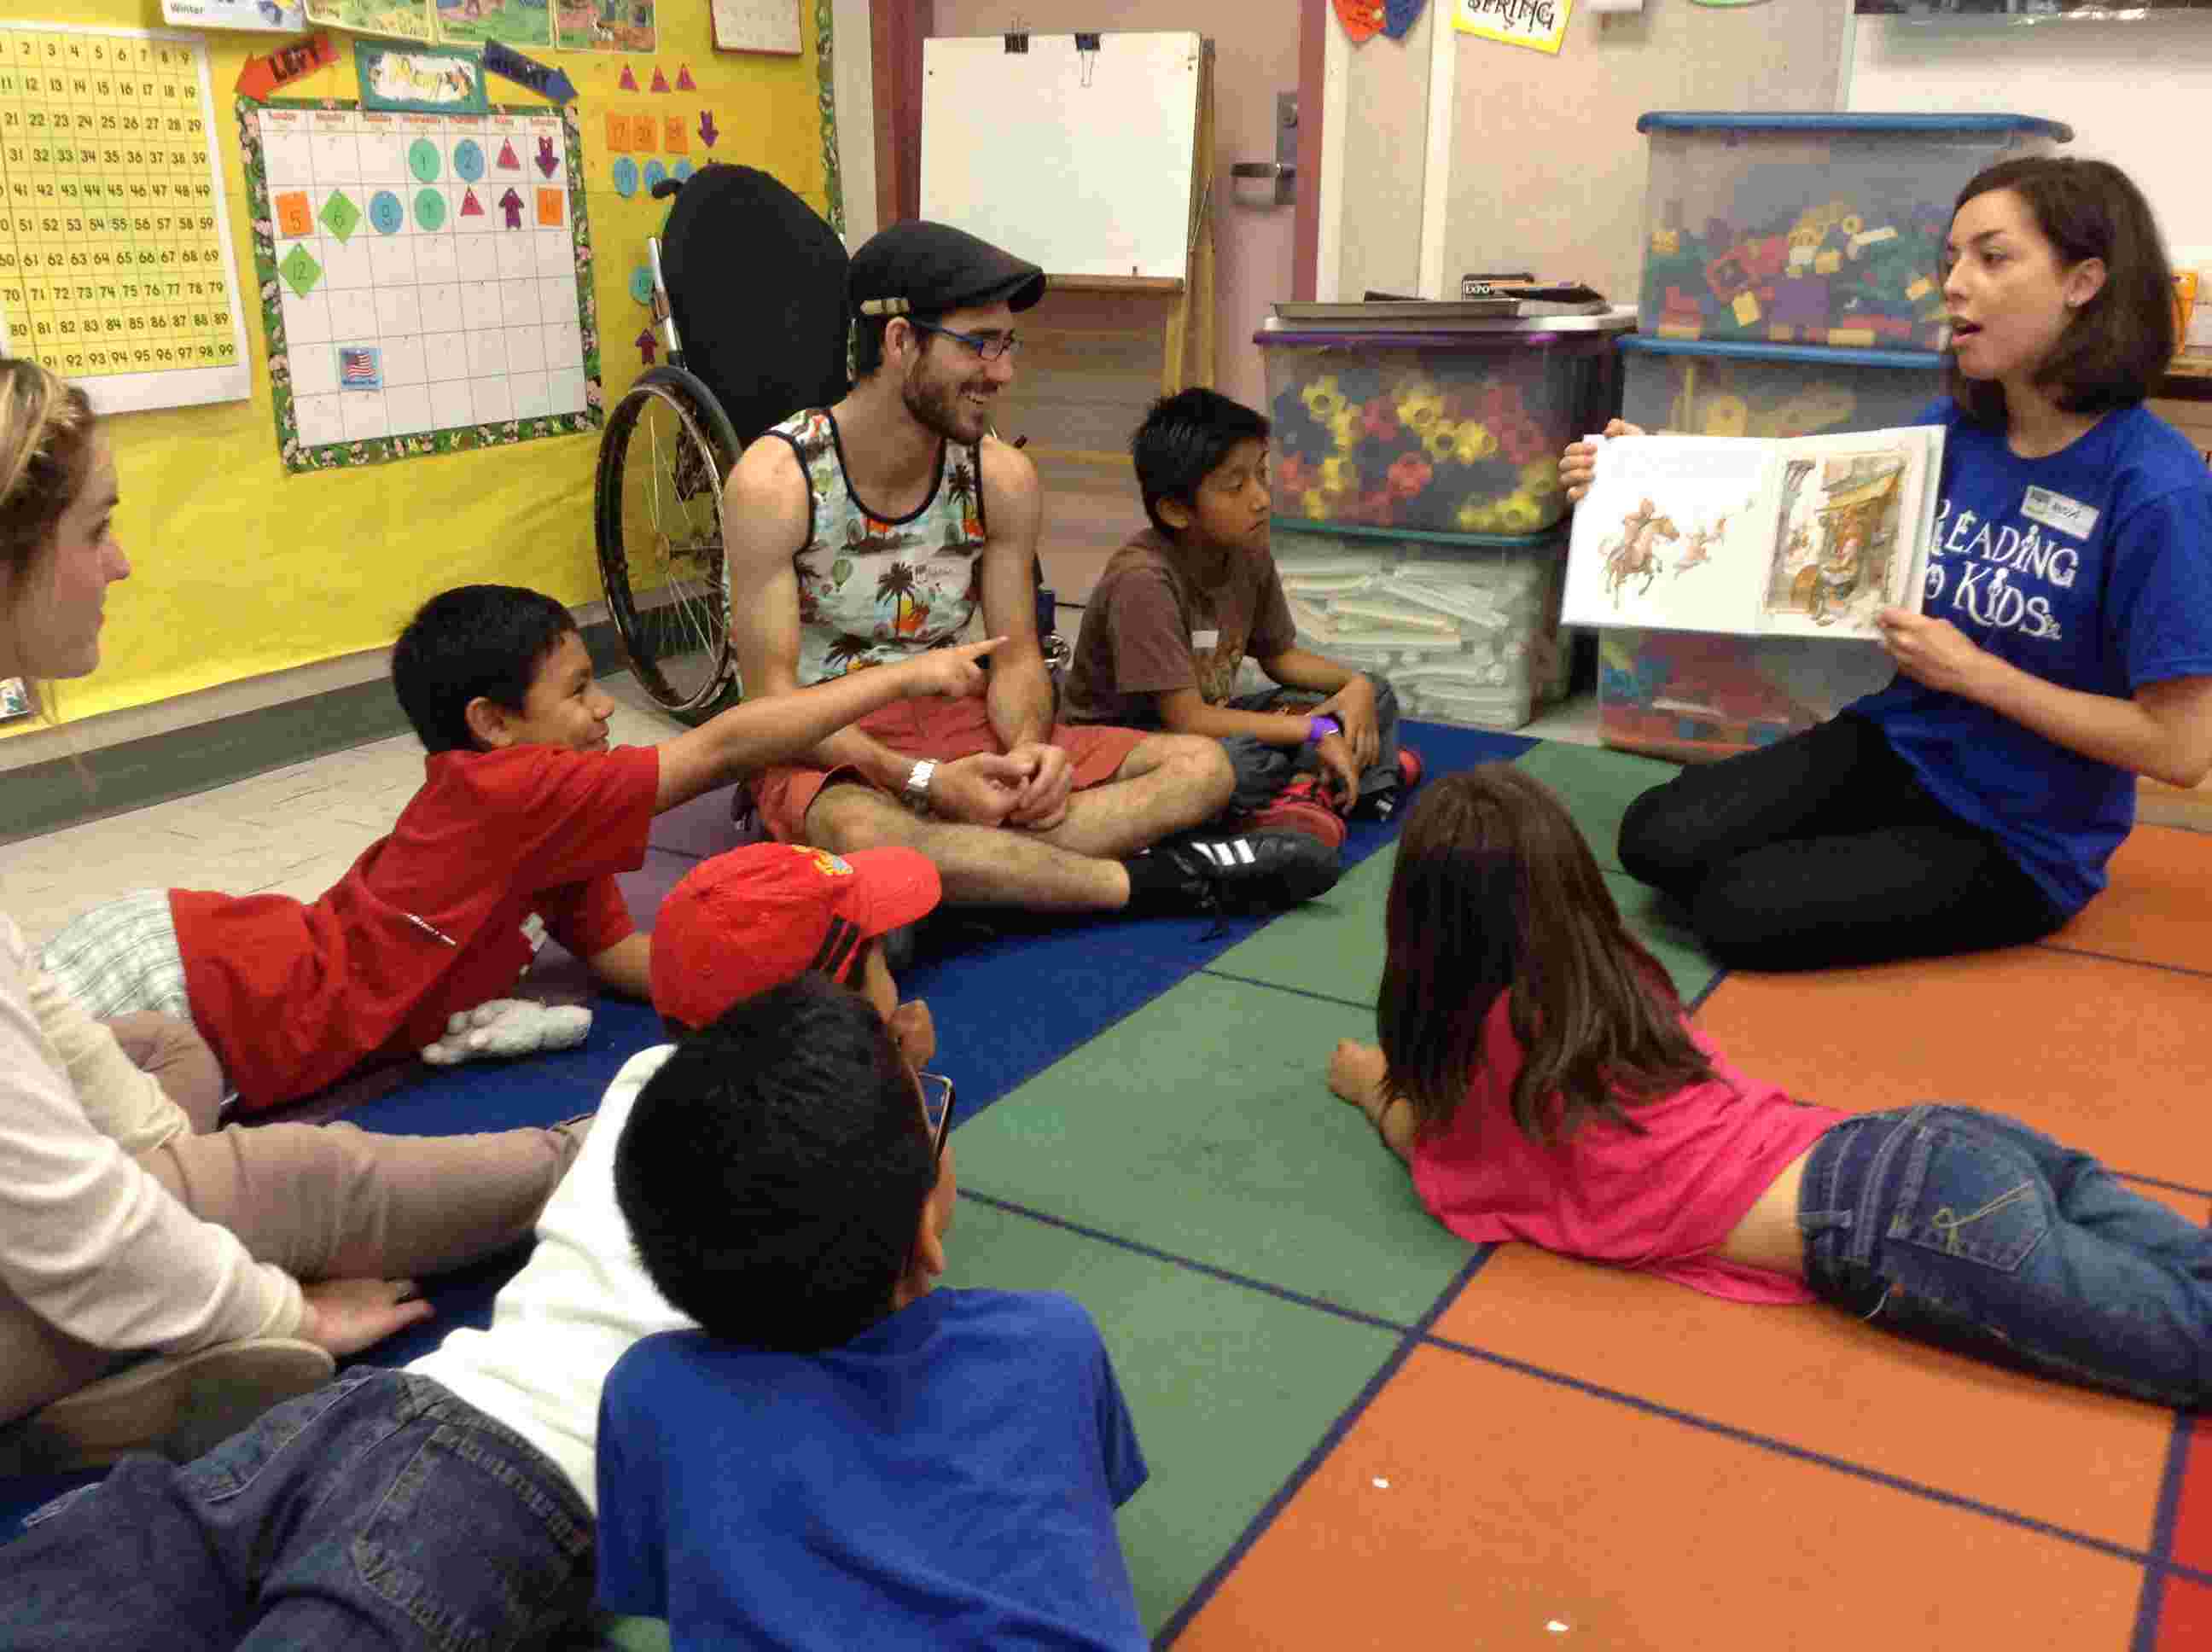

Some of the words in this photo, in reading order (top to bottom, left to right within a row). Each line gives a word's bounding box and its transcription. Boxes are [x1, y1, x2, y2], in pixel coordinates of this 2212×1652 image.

[171, 4, 203, 15] Winter
[22, 43, 30, 55] 2
[48, 44, 55, 56] 3
[71, 46, 79, 57] 4
[96, 46, 102, 59] 5
[118, 49, 126, 61] 6
[141, 49, 147, 61] 7
[180, 50, 189, 64] 9
[1, 78, 12, 89] 11
[26, 77, 38, 90] 12
[50, 79, 61, 91] 13
[74, 80, 86, 92] 14
[97, 82, 109, 96] 15
[120, 84, 132, 95] 16
[143, 84, 153, 96] 17
[164, 85, 174, 97] 18
[184, 86, 195, 98] 19
[4, 112, 19, 125] 21
[29, 113, 44, 126] 22
[55, 114, 68, 127] 23
[78, 115, 92, 128] 24
[101, 116, 115, 129] 25
[124, 116, 138, 130] 26
[146, 118, 159, 130] 27
[167, 118, 181, 131] 28
[188, 119, 201, 132] 29
[9, 148, 23, 161] 31
[34, 148, 48, 162] 32
[57, 149, 73, 162] 33
[80, 150, 96, 163] 34
[104, 150, 119, 163] 35
[127, 151, 143, 164] 36
[150, 151, 163, 164] 37
[193, 152, 206, 164] 39
[14, 184, 27, 196] 41
[37, 184, 53, 195] 42
[61, 184, 77, 197] 43
[84, 184, 100, 196] 44
[108, 184, 123, 196] 45
[130, 184, 146, 197] 46
[152, 184, 166, 196] 47
[175, 184, 189, 197] 48
[195, 184, 210, 196] 49
[0, 218, 9, 231] 0
[20, 218, 32, 231] 51
[43, 218, 58, 231] 52
[67, 218, 82, 231] 53
[89, 218, 104, 231] 54
[112, 218, 128, 230] 55
[157, 218, 171, 230] 57
[179, 218, 194, 230] 58
[200, 217, 213, 230] 59
[290, 210, 301, 231] 5
[334, 207, 346, 229] 6
[23, 254, 38, 266] 61
[48, 253, 63, 266] 62
[71, 253, 87, 265] 63
[94, 253, 109, 265] 64
[116, 252, 132, 265] 65
[139, 253, 155, 264] 66
[161, 251, 175, 263] 67
[183, 250, 198, 262] 68
[204, 250, 218, 261] 69
[294, 259, 308, 281] 12
[3, 289, 20, 302] 70
[31, 288, 44, 300] 71
[54, 287, 68, 300] 72
[77, 287, 92, 299] 73
[99, 287, 115, 298] 74
[123, 285, 137, 297] 75
[143, 284, 160, 296] 76
[166, 282, 180, 294] 77
[188, 282, 202, 294] 78
[208, 282, 224, 293] 79
[10, 325, 26, 336] 80
[38, 322, 50, 334] 81
[60, 321, 75, 334] 82
[84, 319, 99, 332] 83
[106, 319, 121, 331] 84
[130, 317, 143, 329] 85
[150, 316, 166, 328] 86
[172, 315, 186, 327] 87
[214, 312, 228, 325] 89
[43, 356, 57, 367] 91
[67, 355, 82, 366] 92
[89, 353, 106, 364] 93
[112, 352, 128, 364] 94
[134, 350, 150, 362] 95
[156, 348, 172, 360] 96
[178, 347, 192, 358] 97
[199, 346, 213, 357] 98
[218, 344, 234, 355] 99
